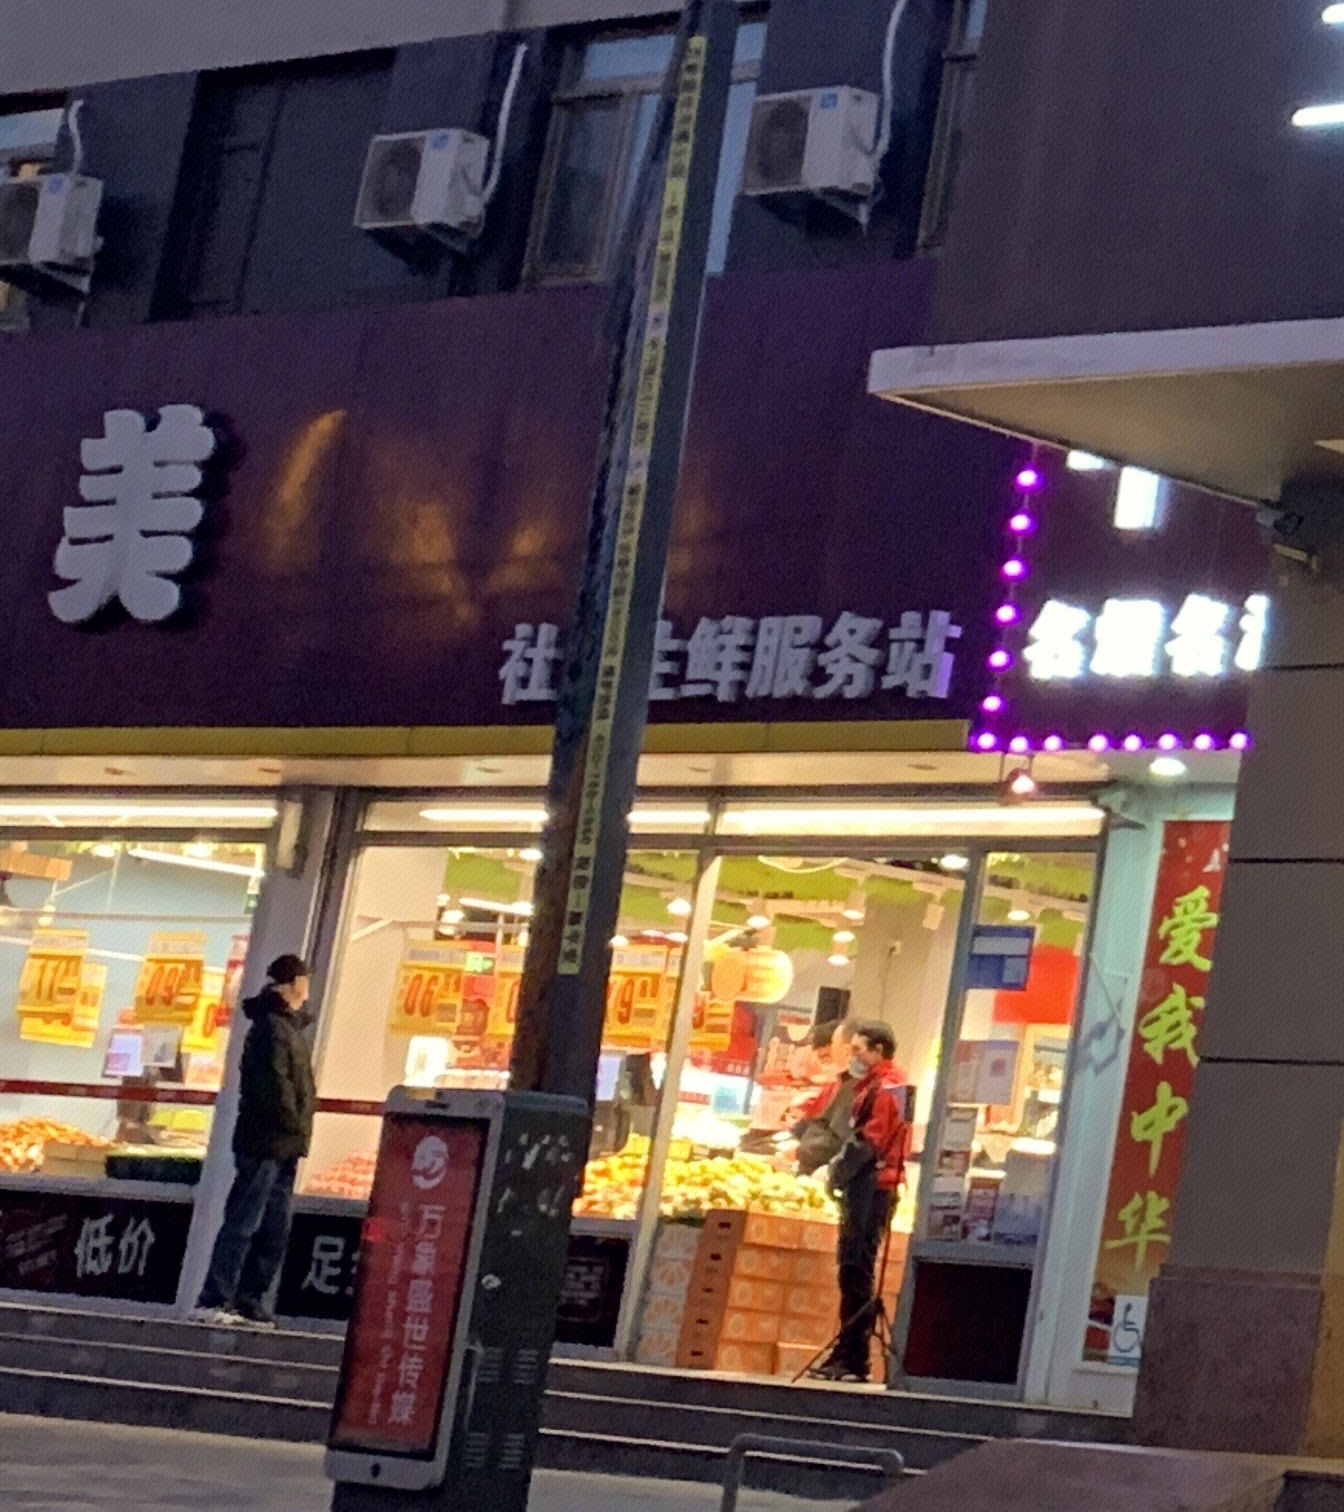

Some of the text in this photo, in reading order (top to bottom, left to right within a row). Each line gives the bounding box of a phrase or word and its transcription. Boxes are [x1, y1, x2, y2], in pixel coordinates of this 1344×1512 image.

[48, 403, 217, 624] 美
[499, 610, 962, 704] 社生鲜服务站
[1102, 884, 1220, 1274] 爱我中华
[74, 1213, 156, 1278] 低价
[302, 1234, 360, 1295] 足
